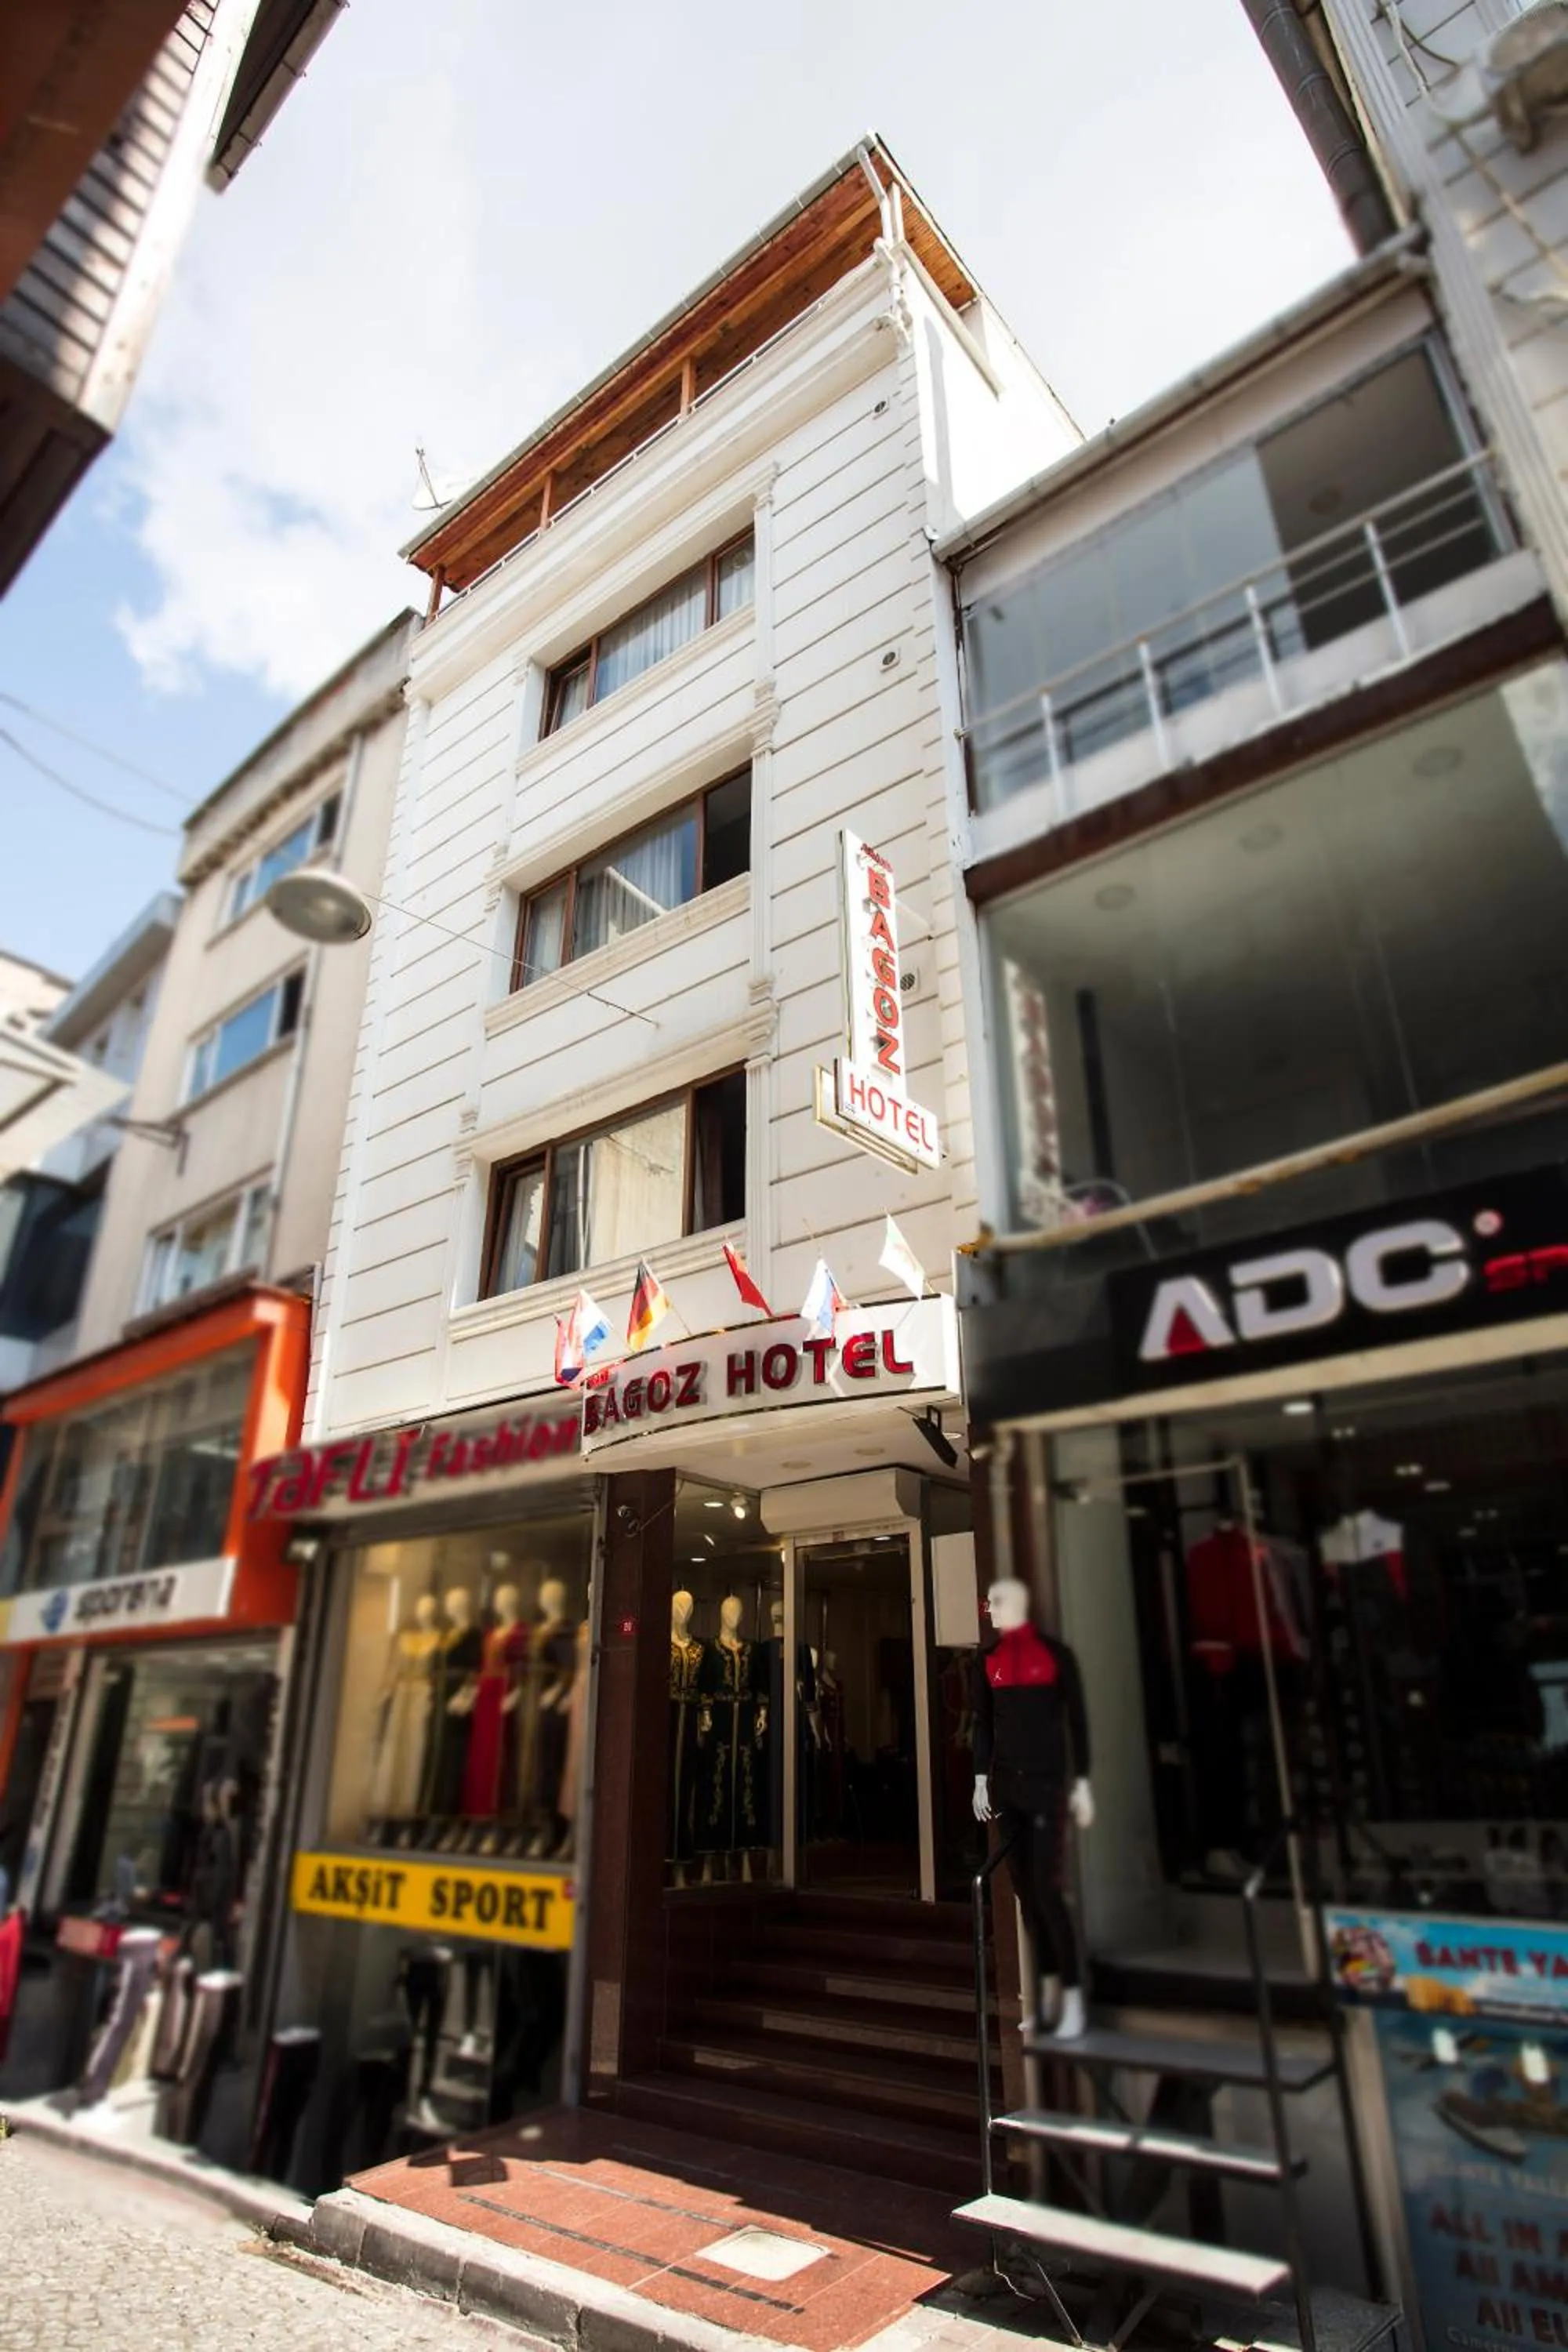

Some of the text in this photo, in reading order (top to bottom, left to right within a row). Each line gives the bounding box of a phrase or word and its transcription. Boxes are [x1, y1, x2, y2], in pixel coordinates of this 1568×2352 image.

[867, 866, 902, 1076] BAGOZ
[849, 1072, 933, 1152] HOTEL
[1138, 1219, 1470, 1361] ADC
[583, 1330, 914, 1436] BAGOZ HOTEL
[430, 1878, 555, 1930] SPORT
